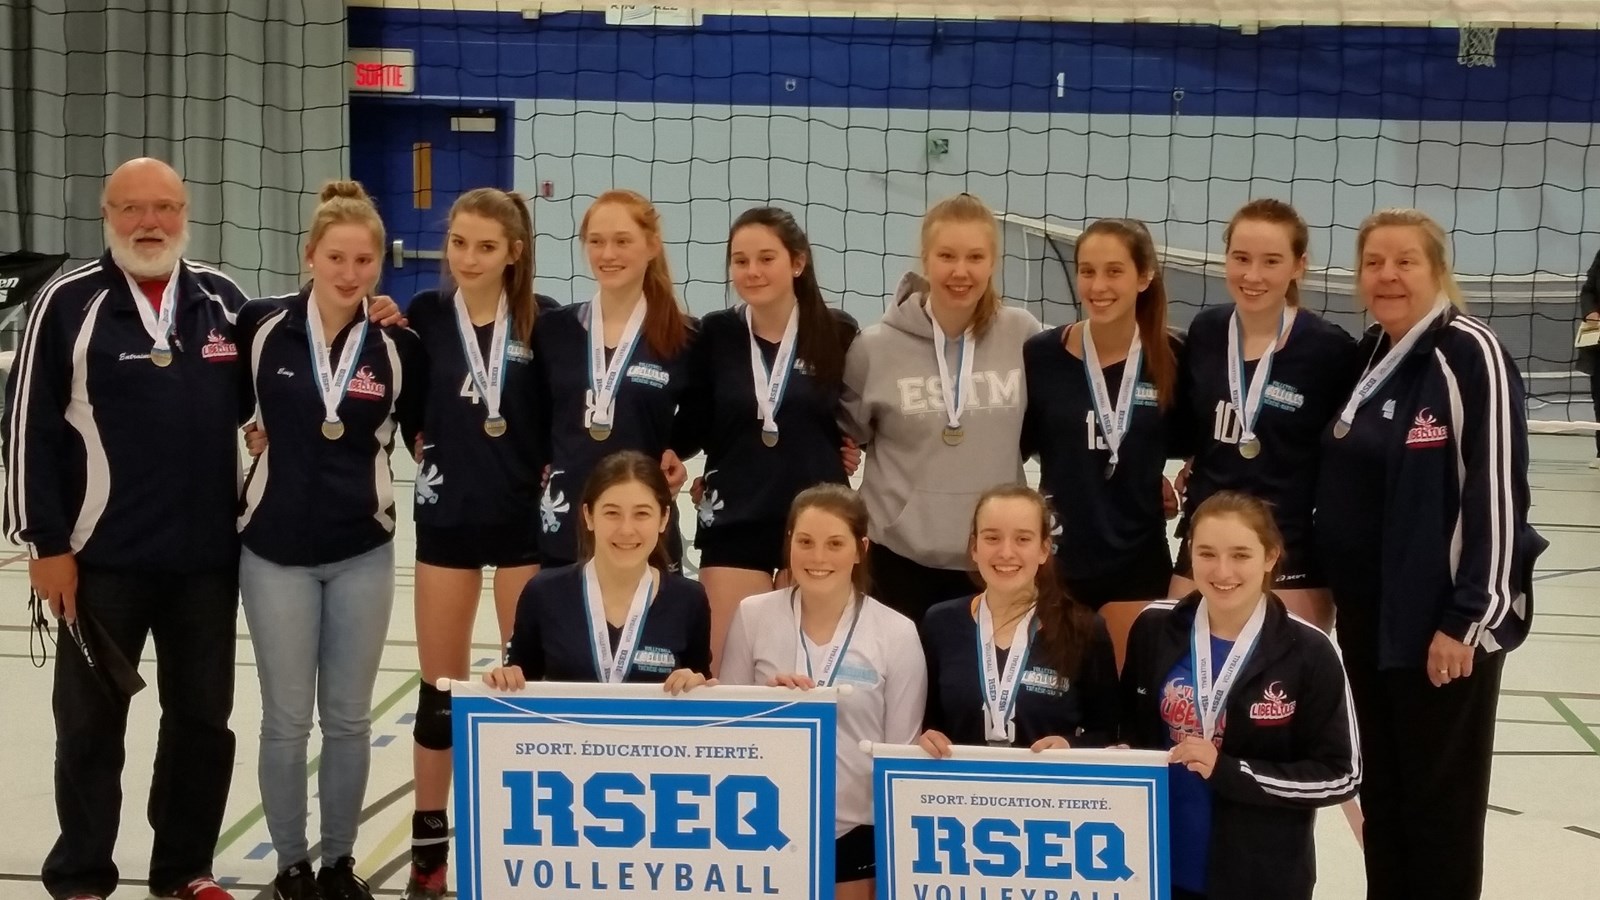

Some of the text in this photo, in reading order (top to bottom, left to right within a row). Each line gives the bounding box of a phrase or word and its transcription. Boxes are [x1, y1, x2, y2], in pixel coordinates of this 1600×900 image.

[356, 63, 404, 87] SORTIE
[1057, 72, 1065, 97] 1
[1213, 399, 1241, 444] 10
[515, 740, 764, 759] SPORT. ÉDUCATION. FIERTÉ.
[502, 770, 791, 852] RSEQ
[920, 793, 1112, 810] SPORT. ÉDUCATION. FIERTÉ.
[911, 815, 1135, 882] RSEQ
[504, 858, 779, 895] VOLLEYBALL
